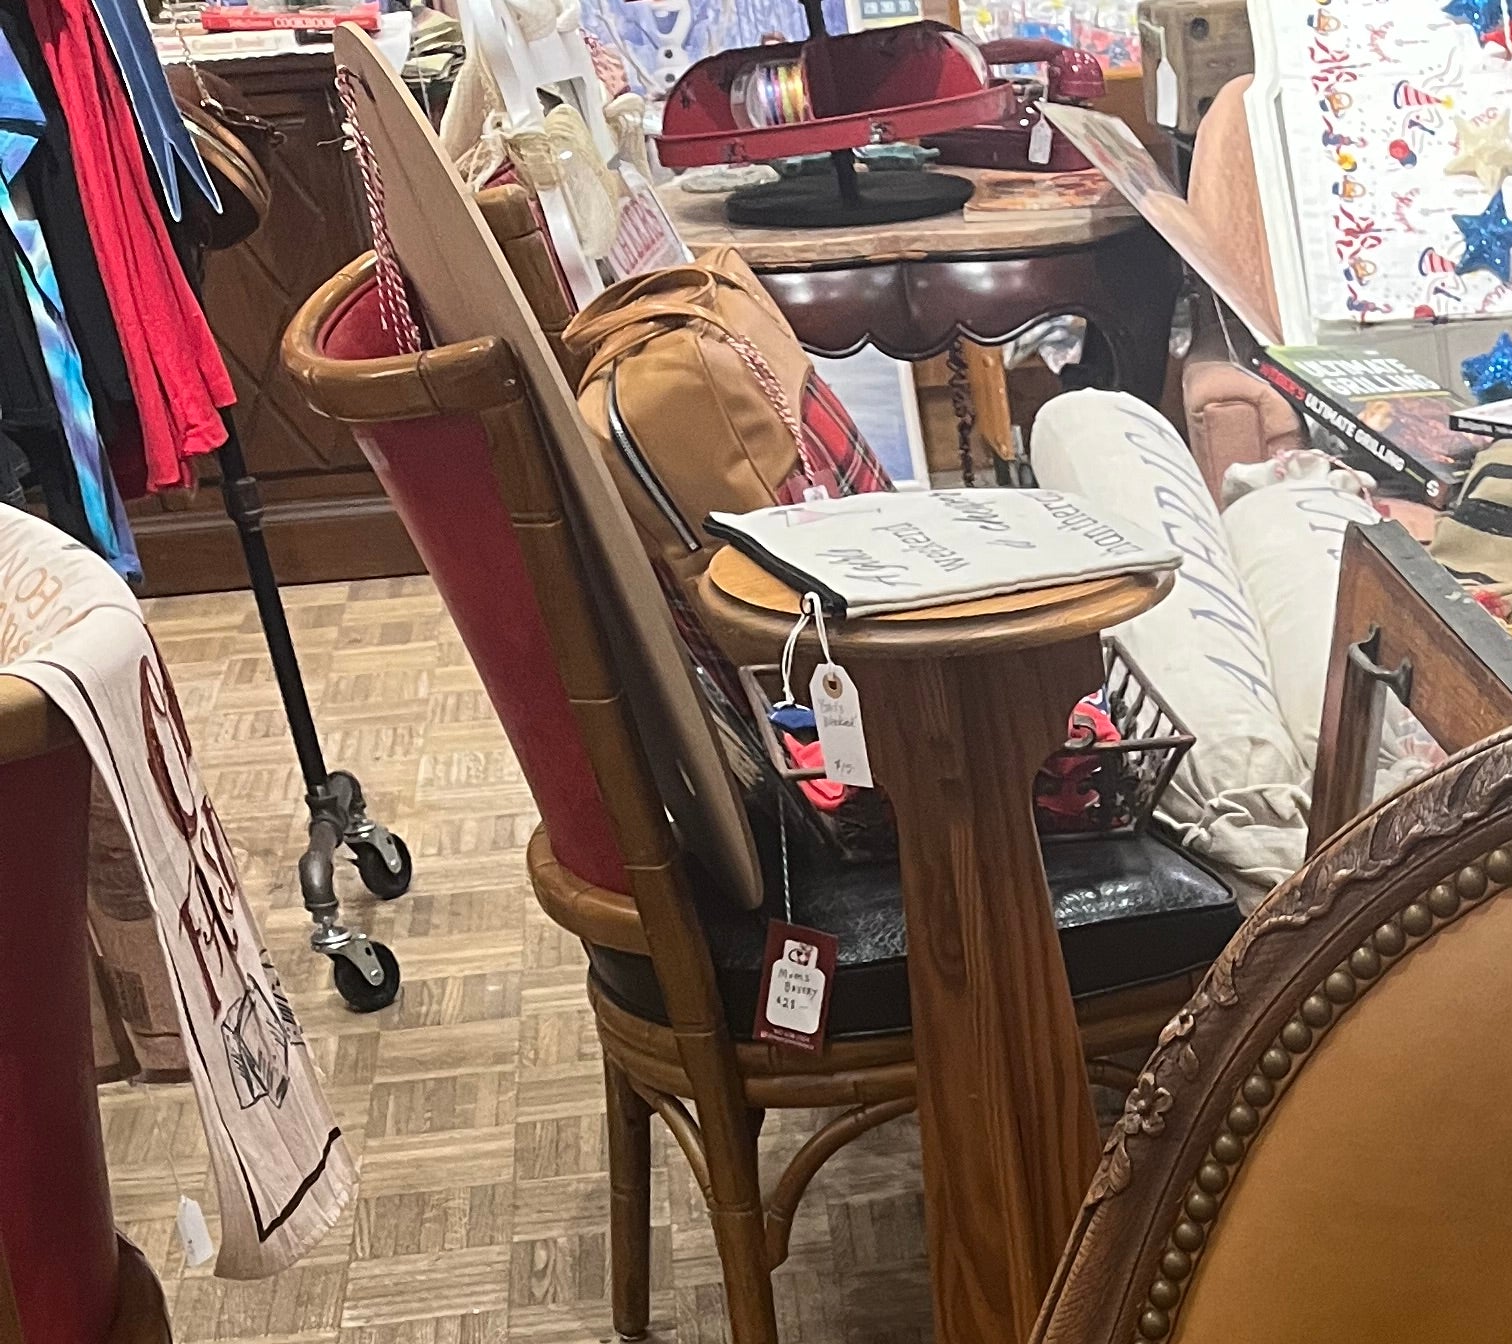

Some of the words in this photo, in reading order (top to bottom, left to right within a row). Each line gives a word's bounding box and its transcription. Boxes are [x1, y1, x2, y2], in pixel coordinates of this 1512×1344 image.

[1294, 357, 1416, 377] ULTIMATE
[1321, 374, 1442, 396] GRILLING
[1304, 392, 1358, 438] ULTIMATE
[1354, 428, 1406, 473] GRILLING
[872, 522, 971, 572] weekend
